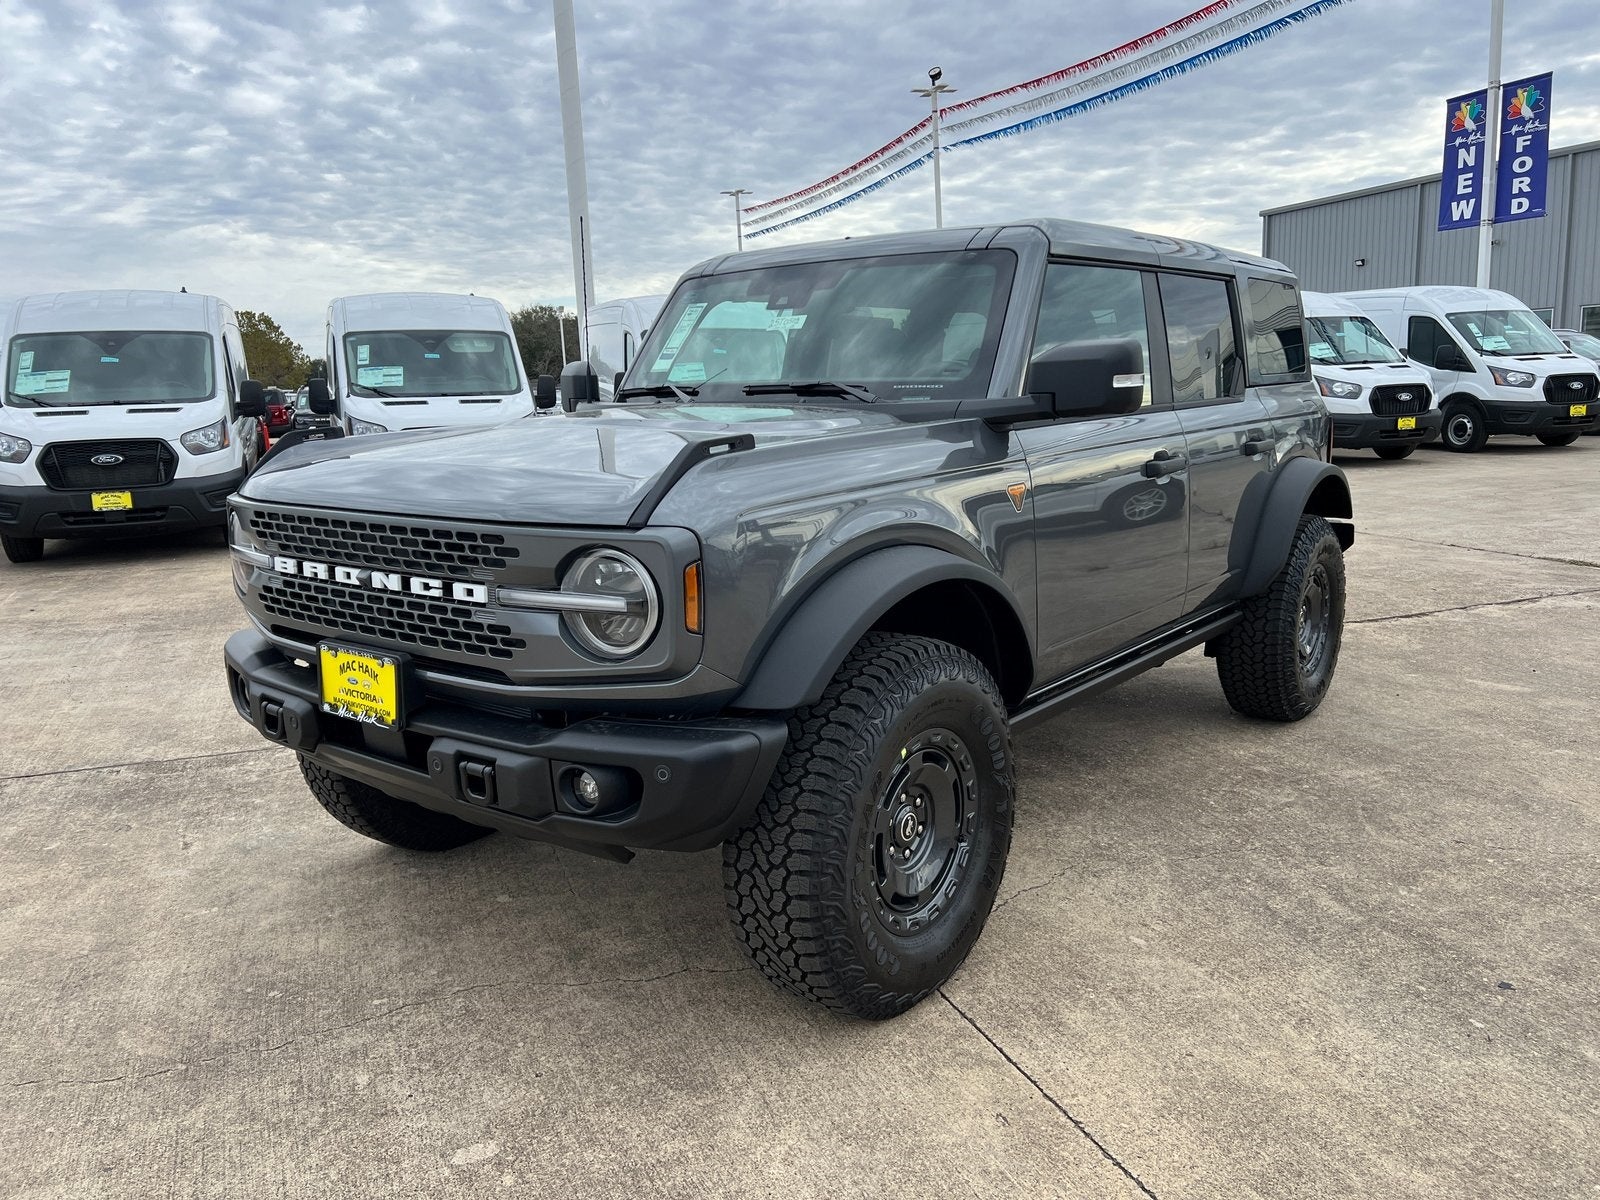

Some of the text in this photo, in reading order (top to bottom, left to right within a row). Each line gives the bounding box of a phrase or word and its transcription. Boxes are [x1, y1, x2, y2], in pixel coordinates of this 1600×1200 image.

[1451, 146, 1476, 221] NEW
[1511, 135, 1533, 214] FORD
[274, 556, 488, 604] BRONCO
[340, 660, 379, 685] MAC HAIK
[333, 696, 391, 717] MACHAIKVICTORIA.COM
[344, 687, 377, 704] VICTORIA
[337, 704, 356, 719] Mac
